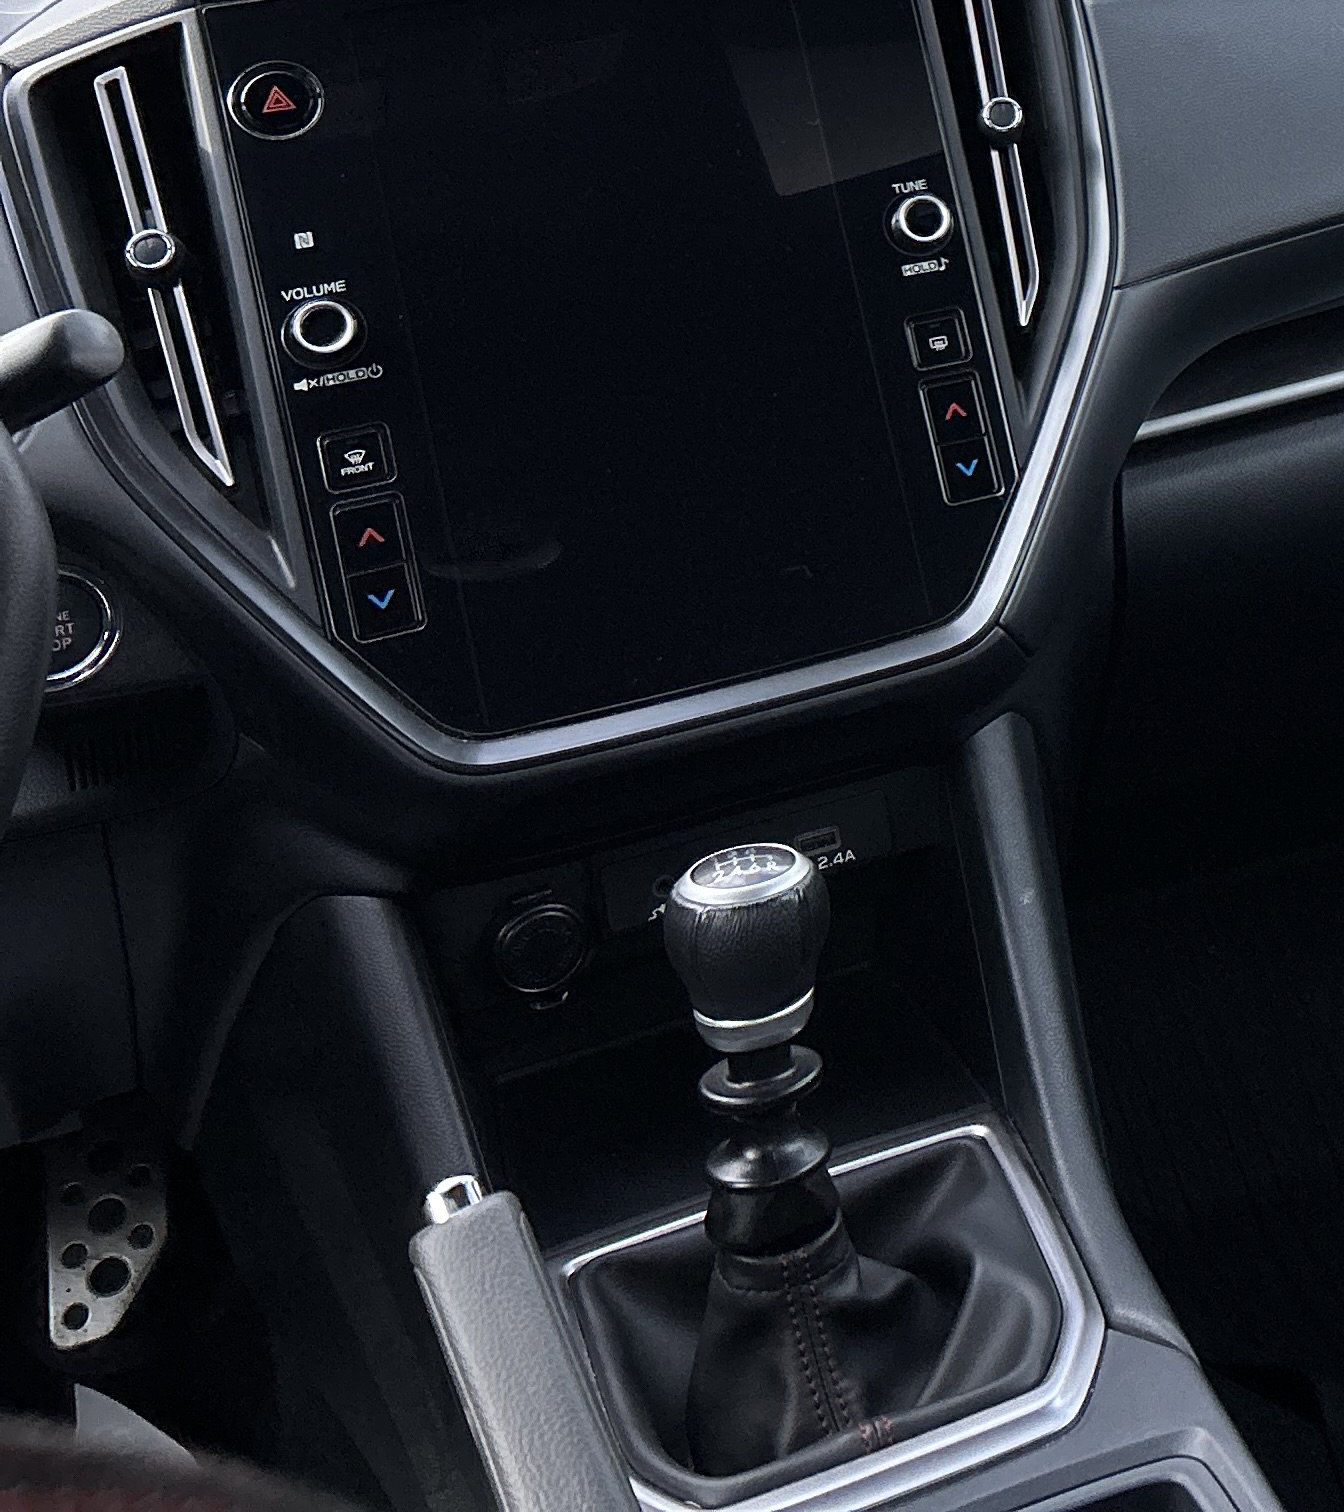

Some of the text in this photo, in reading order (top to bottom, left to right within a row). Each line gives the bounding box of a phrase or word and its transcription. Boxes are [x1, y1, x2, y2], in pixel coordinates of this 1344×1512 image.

[892, 178, 929, 194] TUNE
[280, 279, 347, 303] VOLUME
[340, 461, 375, 477] FRONT
[816, 849, 857, 871] 2.4A
